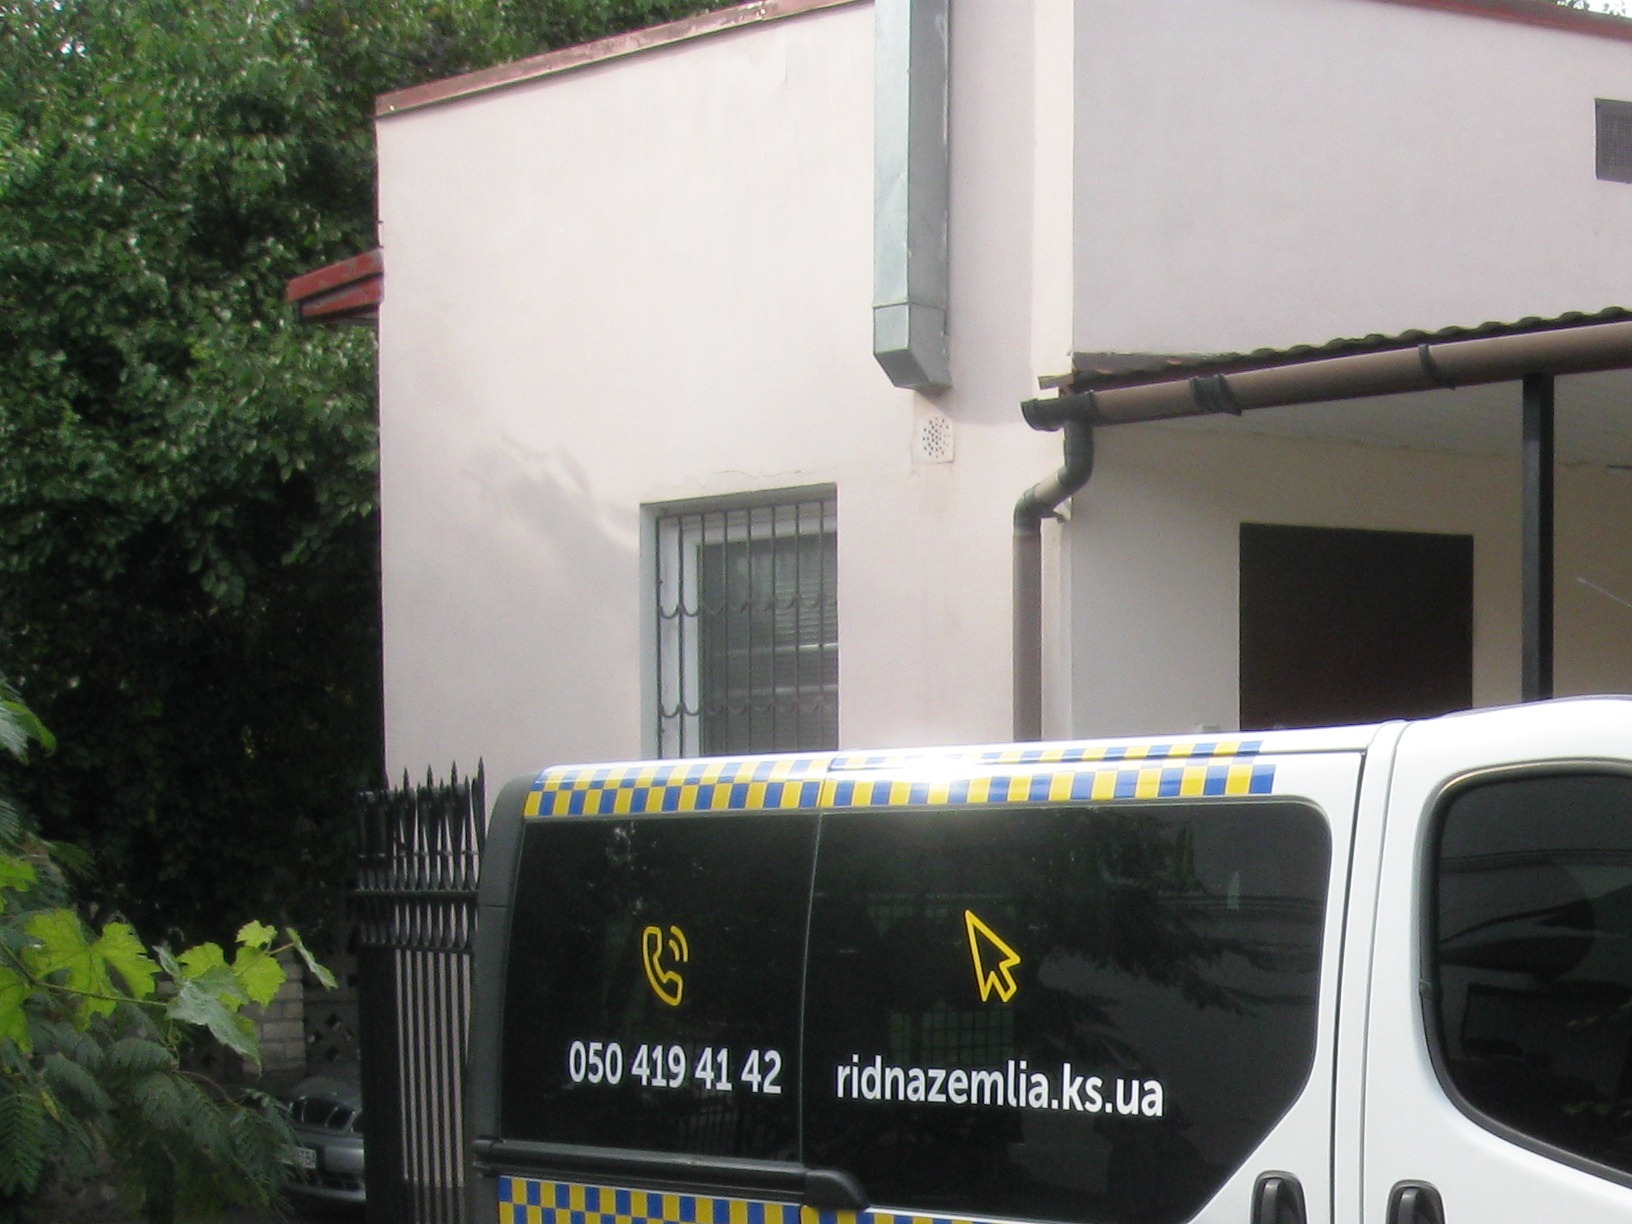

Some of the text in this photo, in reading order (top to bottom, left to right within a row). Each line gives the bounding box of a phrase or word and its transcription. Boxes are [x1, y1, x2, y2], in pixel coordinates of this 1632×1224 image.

[569, 1040, 783, 1095] 050 419 41 42
[836, 1053, 1164, 1117] ridnazemlia.ks.ua
